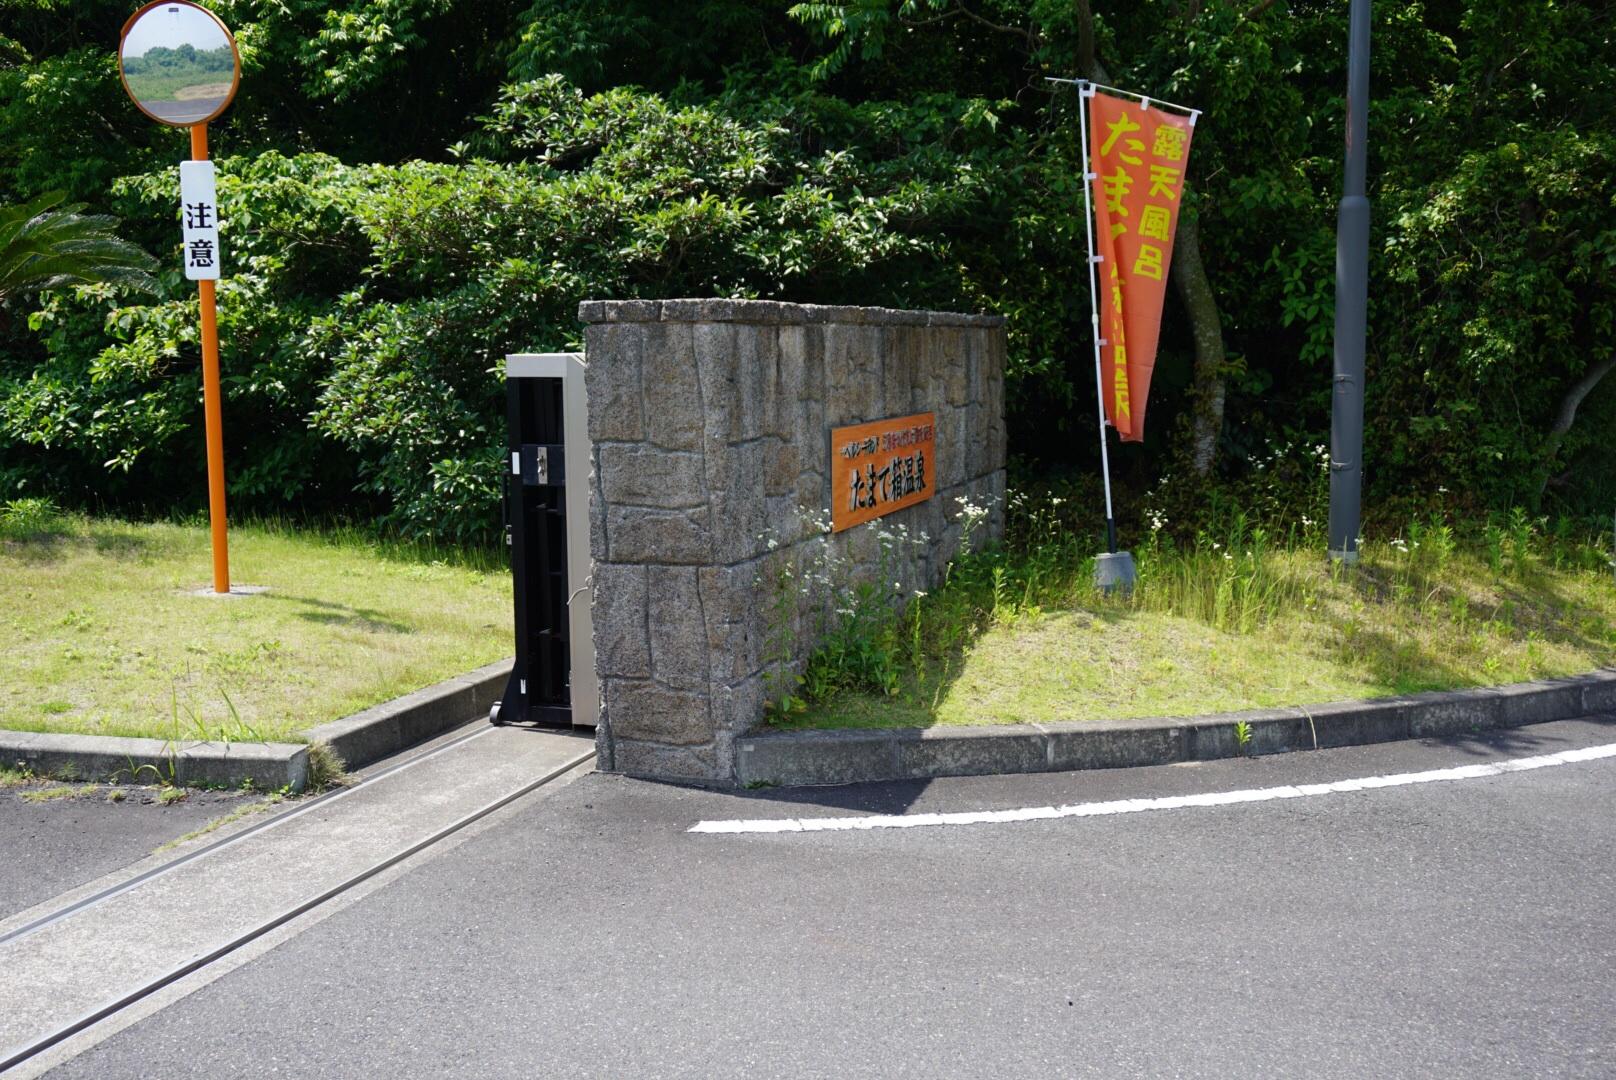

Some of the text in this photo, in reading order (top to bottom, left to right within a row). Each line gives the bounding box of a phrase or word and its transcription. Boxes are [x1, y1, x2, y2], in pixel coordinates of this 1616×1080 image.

[186, 202, 214, 268] 注意
[1133, 123, 1187, 281] 露天風呂
[849, 450, 927, 513] たまて箱温泉
